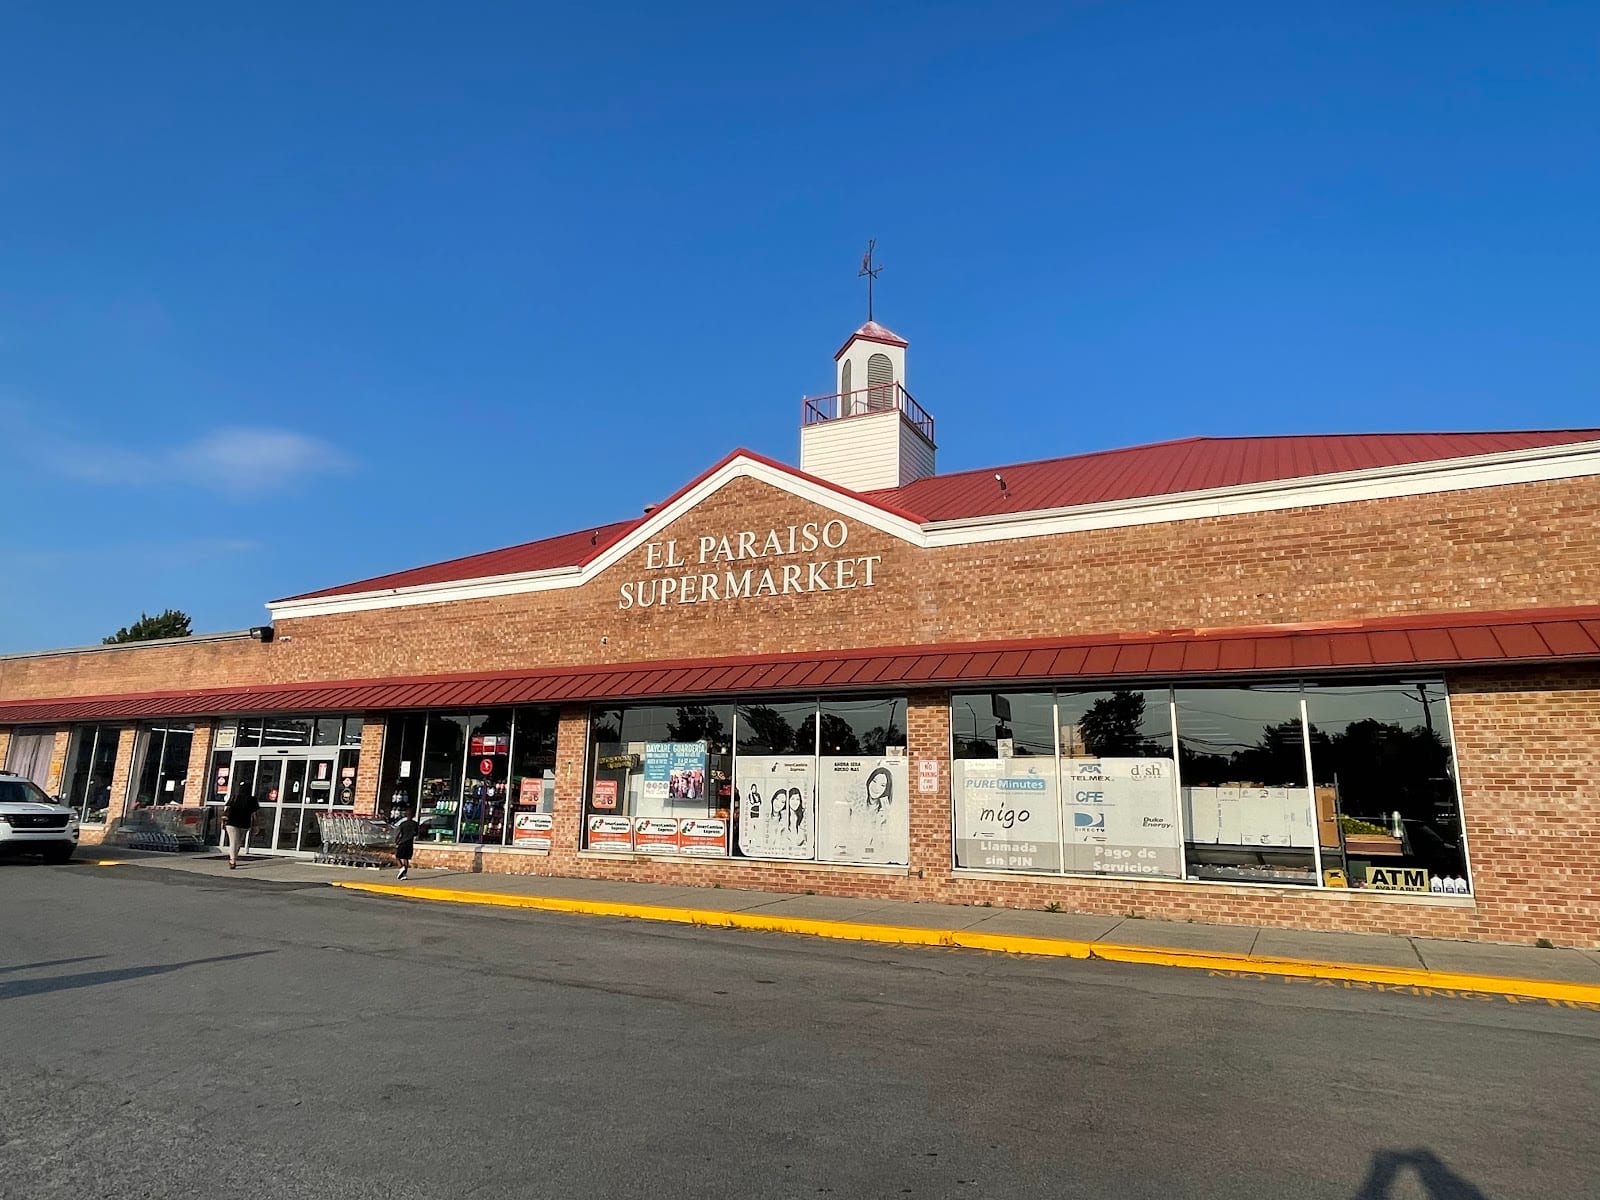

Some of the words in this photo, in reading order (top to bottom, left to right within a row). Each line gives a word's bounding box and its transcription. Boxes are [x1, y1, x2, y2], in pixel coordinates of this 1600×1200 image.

[644, 539, 685, 570] EL
[698, 518, 848, 564] PARAISO
[618, 554, 882, 610] SUPERMARKET
[646, 743, 671, 753] DAYCARE
[1130, 764, 1160, 776] dsh
[966, 779, 997, 789] PURE
[999, 780, 1044, 789] Minutes
[1076, 791, 1104, 803] CFE
[980, 801, 1031, 829] migo
[980, 841, 1038, 853] Llamada
[1095, 846, 1132, 860] Pago
[1138, 848, 1157, 859] de
[985, 855, 1004, 865] sin
[1009, 856, 1033, 866] PIN
[1093, 861, 1160, 873] Servicios
[1371, 869, 1425, 887] ATM
[1208, 970, 1267, 981] NO
[1284, 975, 1494, 1002] PARKING
